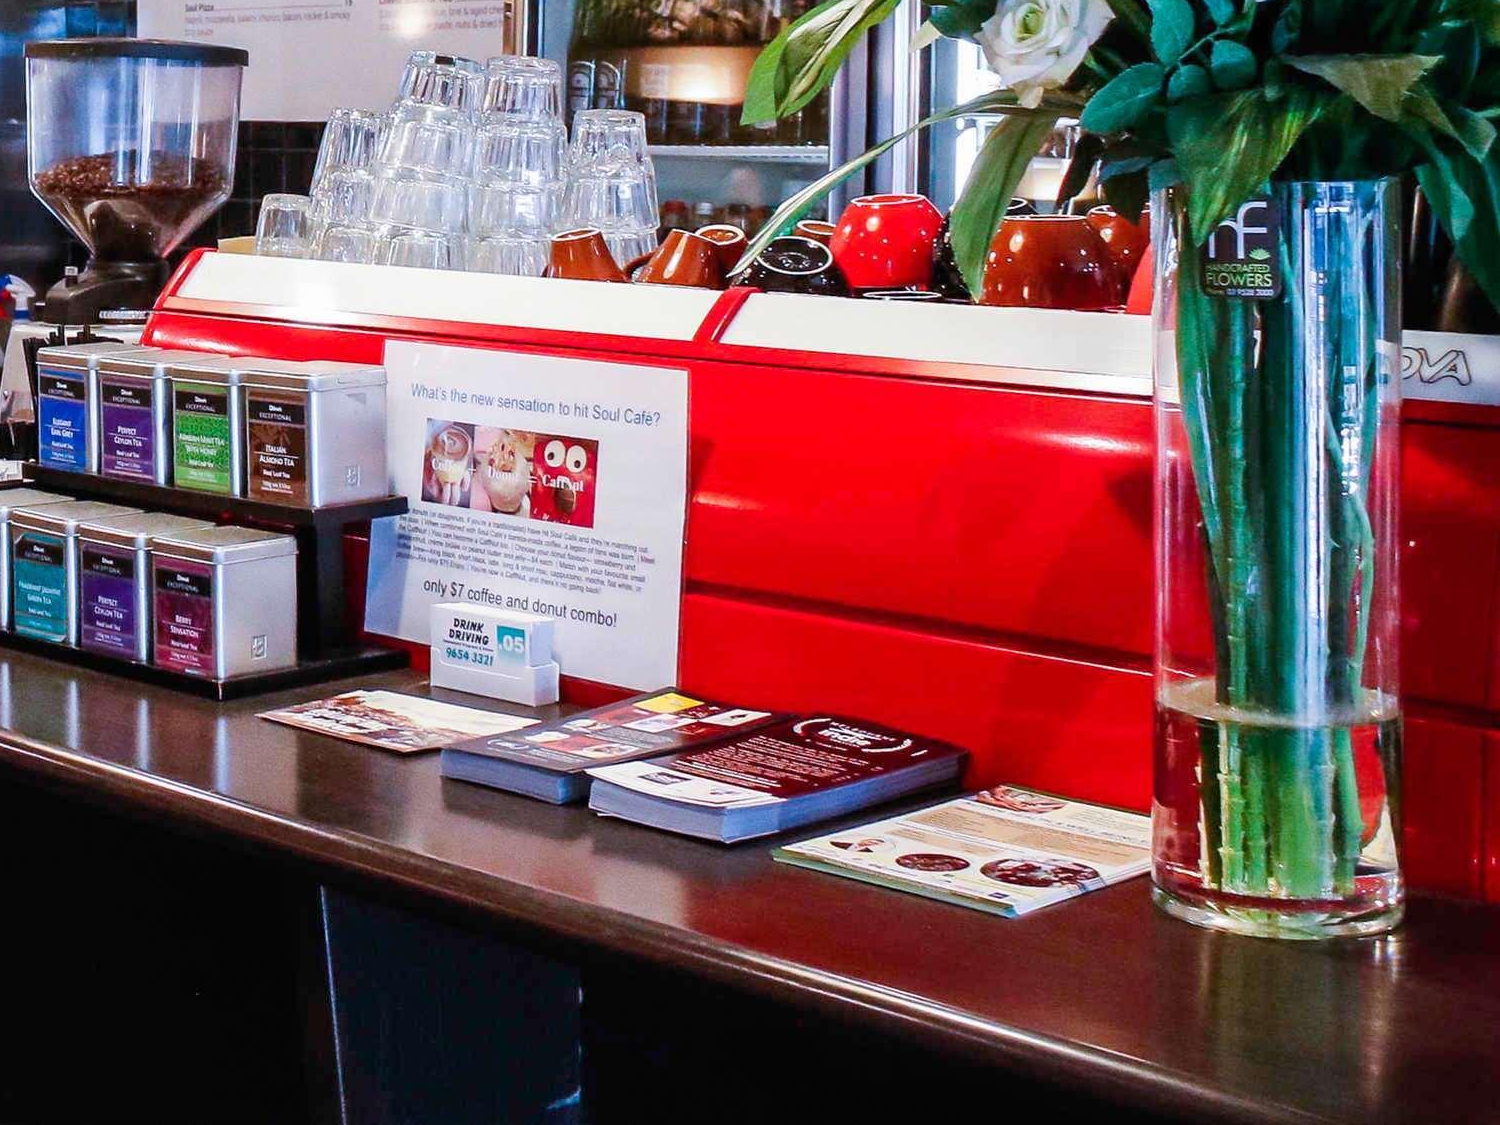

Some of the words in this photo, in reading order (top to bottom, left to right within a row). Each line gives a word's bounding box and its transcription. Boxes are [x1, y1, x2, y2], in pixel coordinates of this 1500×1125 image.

[1206, 273, 1273, 287] FLOWERS
[411, 383, 447, 401] What's
[450, 388, 468, 403] the
[470, 394, 494, 407] new
[497, 395, 555, 414] sensation
[558, 403, 570, 416] to
[574, 403, 588, 418] hit
[592, 405, 620, 422] Soul
[623, 408, 661, 427] Café?
[259, 412, 292, 422] EXCEPTIONAL
[265, 444, 287, 454] ITALIAN
[260, 455, 283, 465] ALMOND
[284, 457, 295, 467] TEA
[423, 579, 447, 598] only
[450, 581, 465, 597] $7
[468, 587, 502, 605] coffee
[506, 595, 529, 611] and
[533, 599, 567, 618] donut
[570, 607, 617, 627] combo!
[94, 606, 113, 617] CEYLON
[113, 609, 123, 619] TEA
[170, 625, 199, 638] SENSATION
[453, 618, 484, 633] DRINK
[449, 629, 489, 646] DRIVING
[445, 647, 469, 662] 9654
[471, 651, 494, 667] 3321
